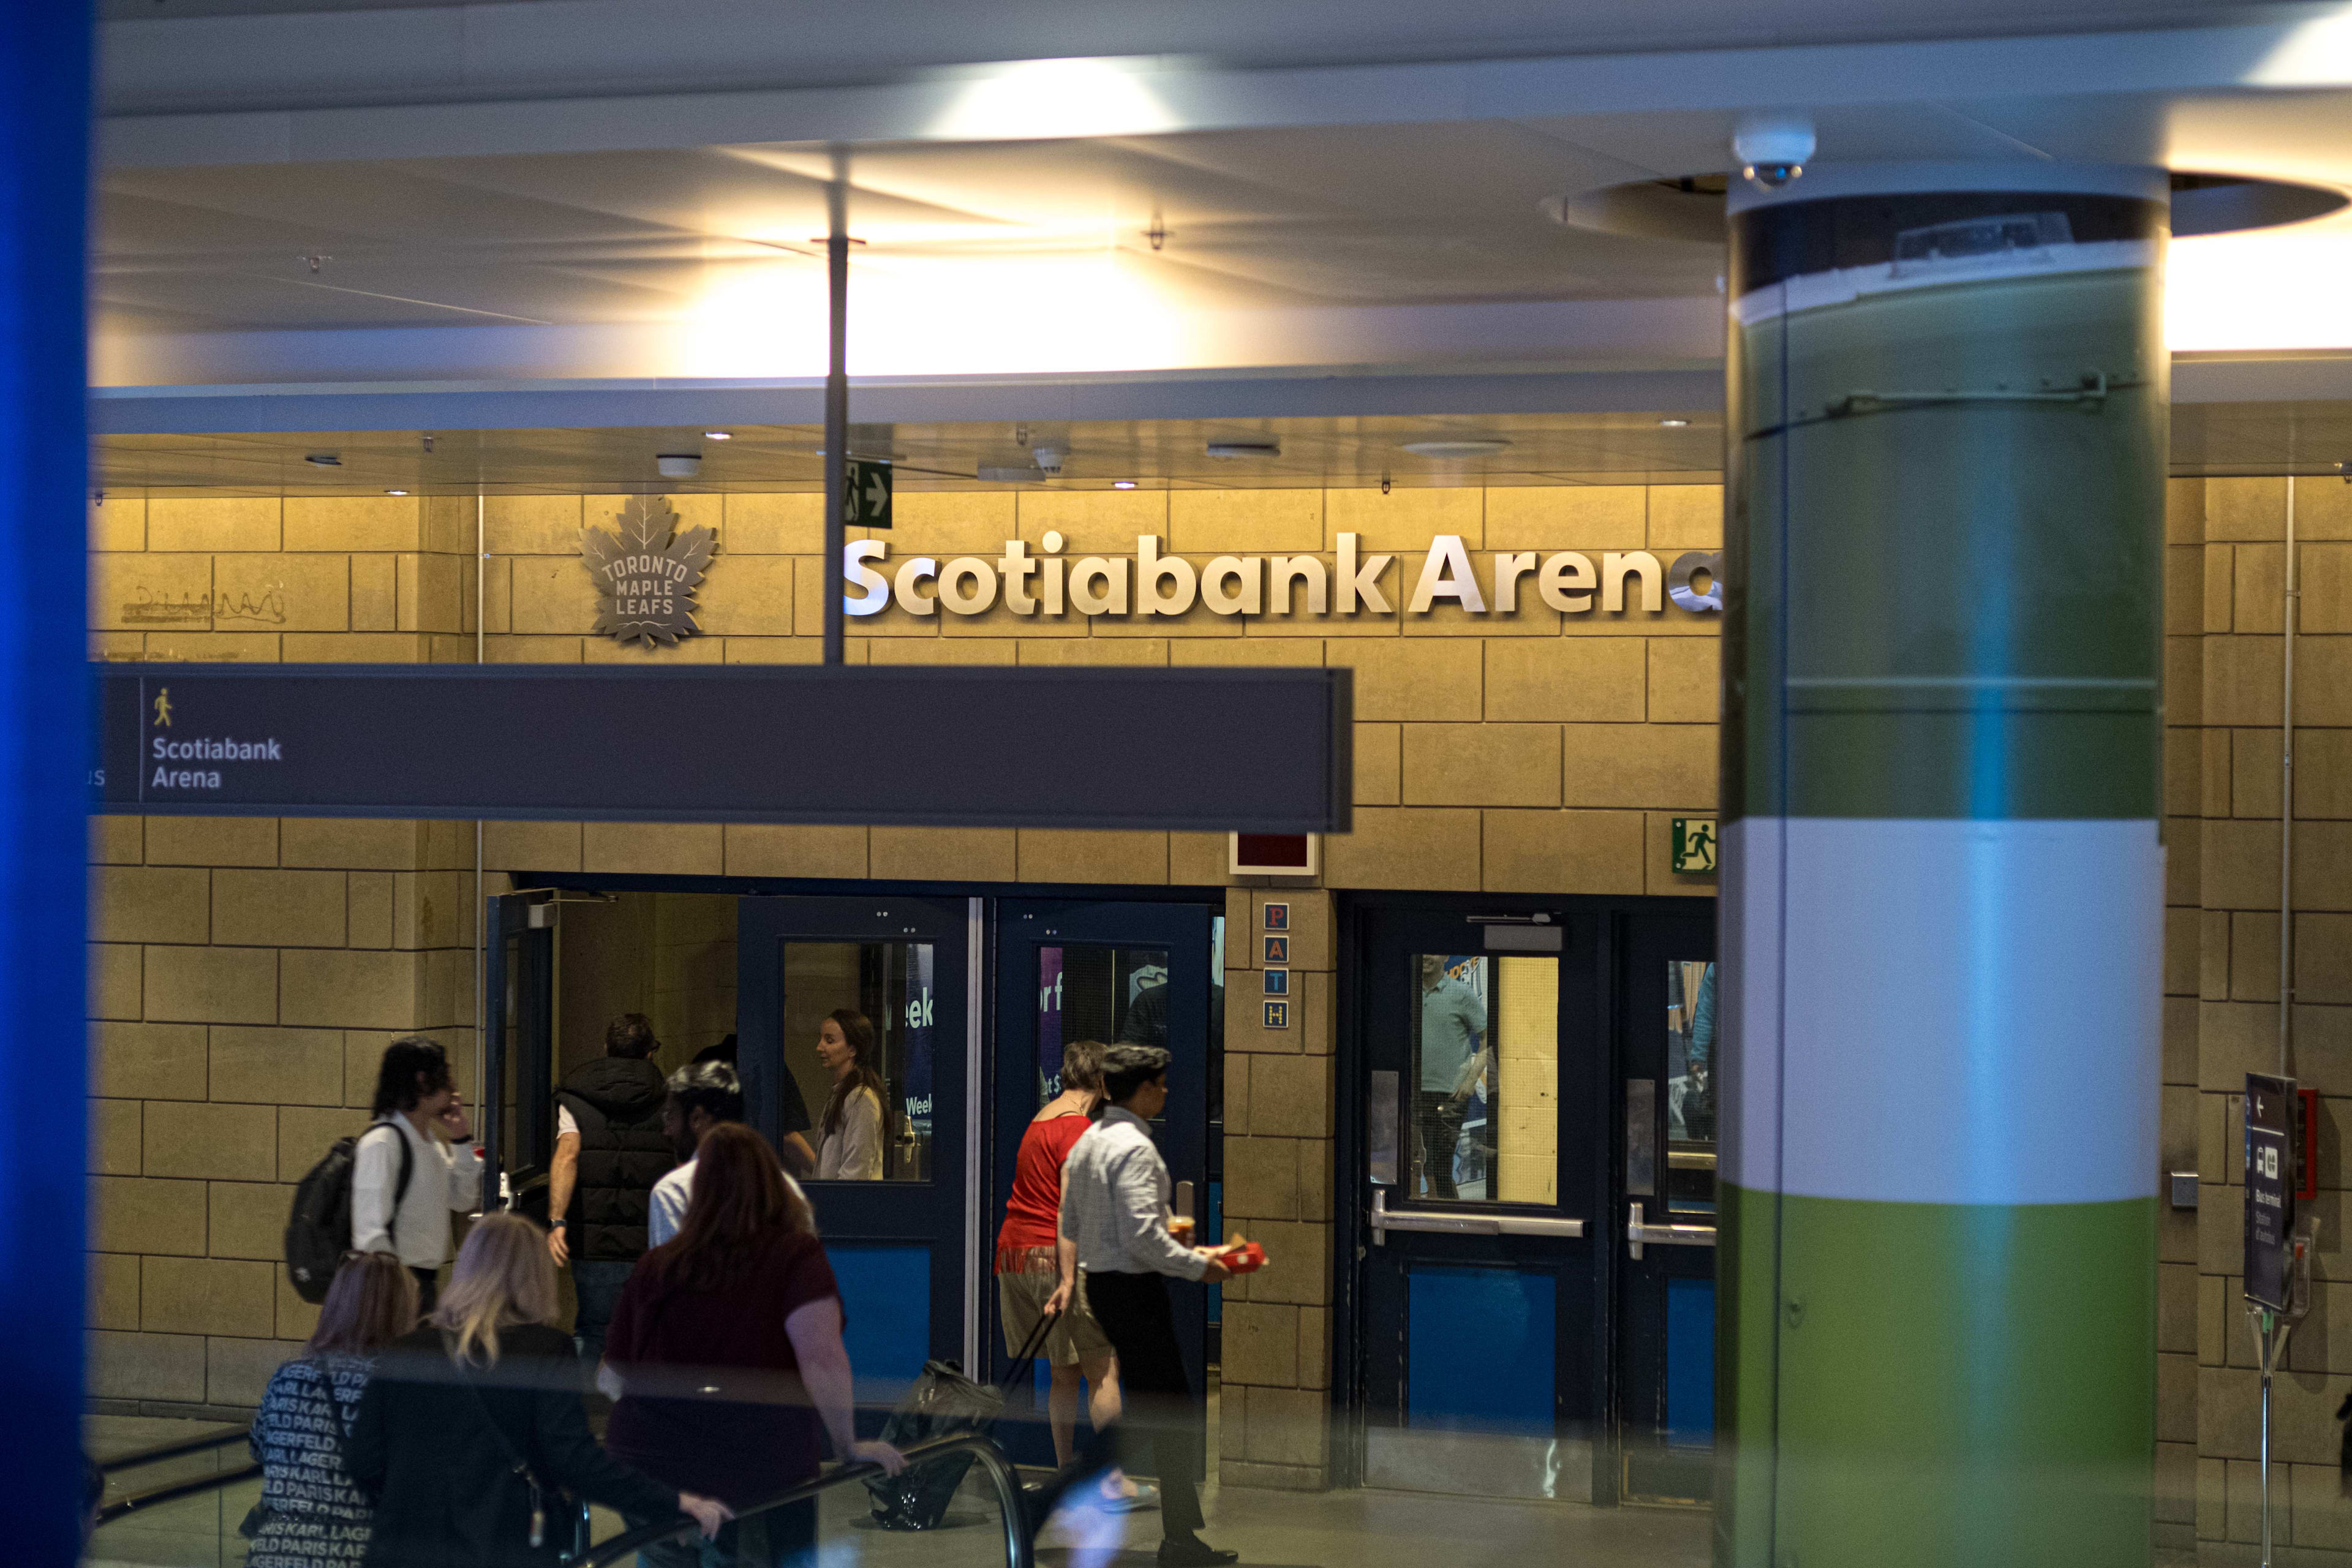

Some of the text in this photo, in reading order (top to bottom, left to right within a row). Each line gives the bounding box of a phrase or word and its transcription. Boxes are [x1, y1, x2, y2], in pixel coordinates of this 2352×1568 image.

[601, 555, 687, 582] TORONTO
[843, 531, 1724, 616] Scotiabank Arena
[616, 580, 673, 596] MAPLE
[616, 599, 673, 615] LEAFS
[153, 737, 281, 760] Scotiabank
[151, 766, 221, 788] Arena
[1268, 907, 1284, 1025] PATH
